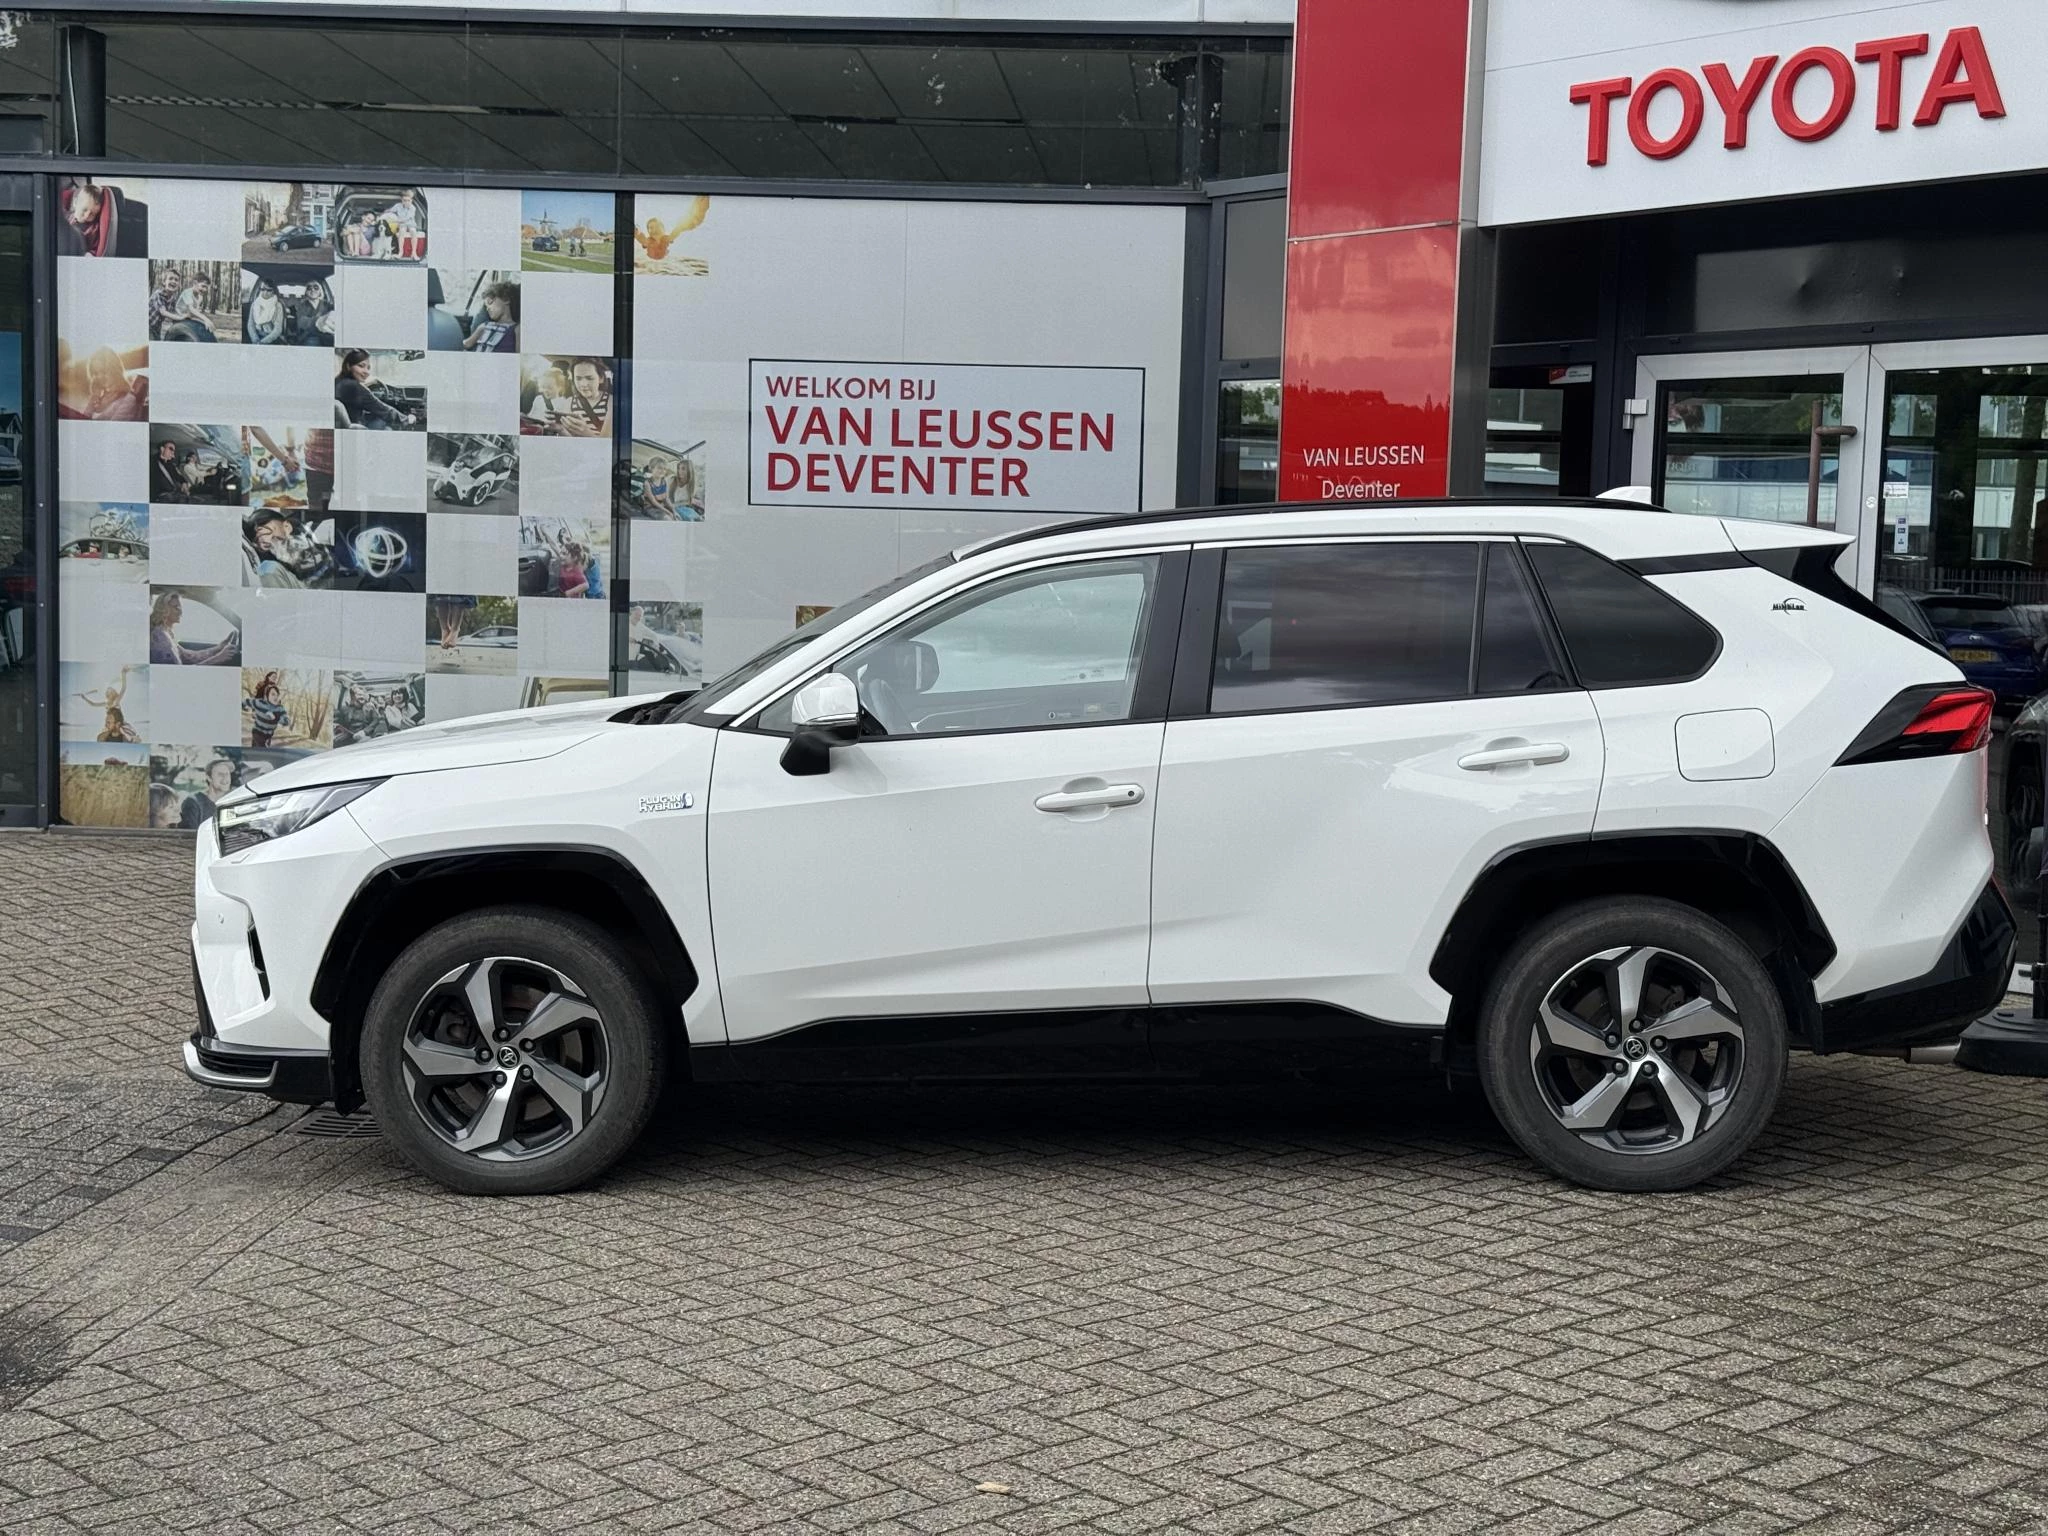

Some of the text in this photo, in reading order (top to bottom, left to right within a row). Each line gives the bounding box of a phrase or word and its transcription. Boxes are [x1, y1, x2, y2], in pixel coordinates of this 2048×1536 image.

[1570, 26, 2007, 167] TOYOTA
[766, 375, 936, 400] WELKOM BIJ
[764, 405, 1114, 452] VAN LEUSSEN
[1303, 445, 1425, 467] VAN LEUSSEN
[767, 452, 1031, 497] DEVENTER
[1321, 479, 1400, 499] Deventer
[639, 800, 683, 813] HYBRID
